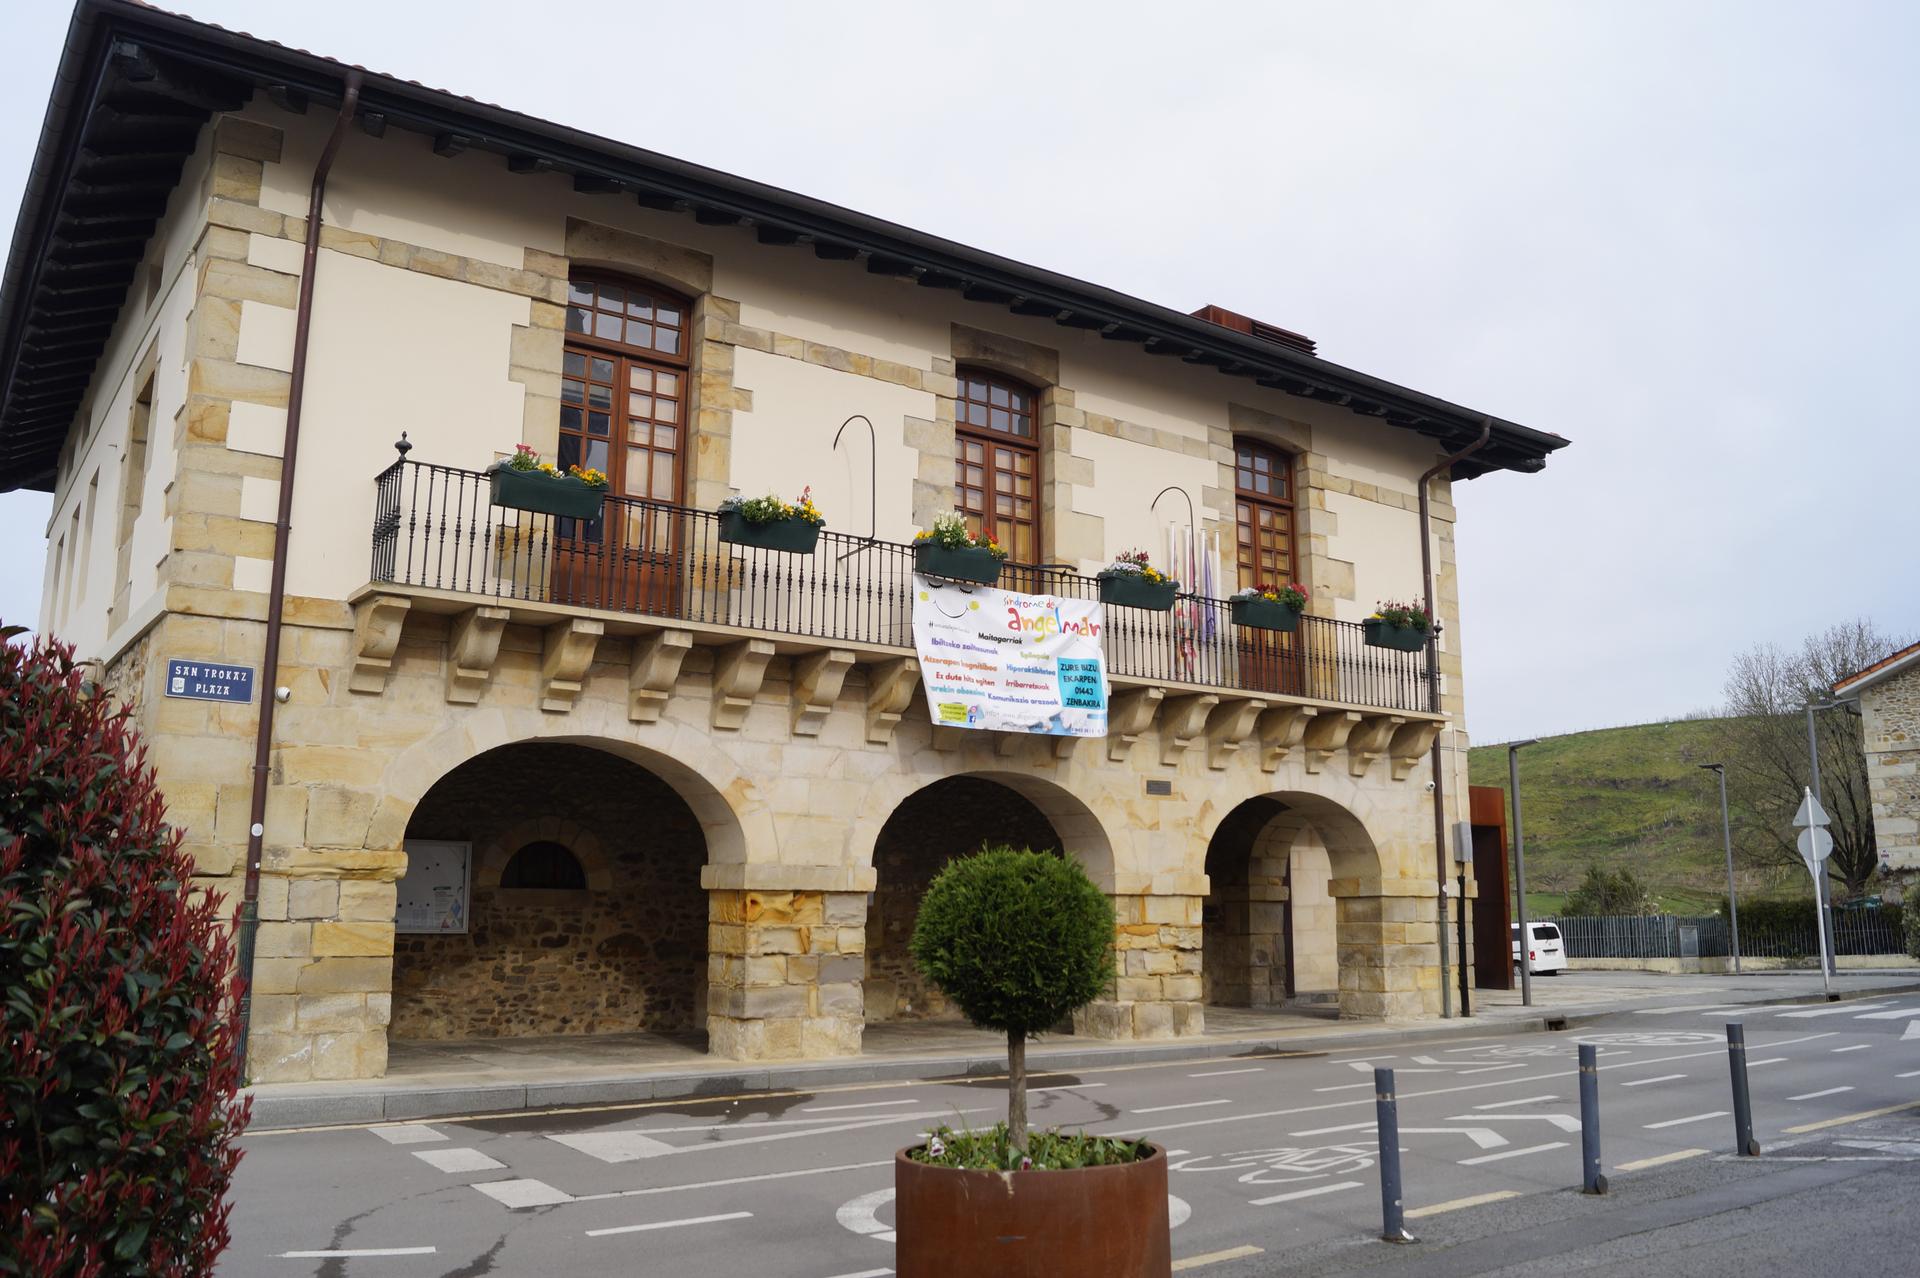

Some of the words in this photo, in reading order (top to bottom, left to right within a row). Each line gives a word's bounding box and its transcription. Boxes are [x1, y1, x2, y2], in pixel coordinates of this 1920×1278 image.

[1008, 607, 1101, 643] angelman
[931, 637, 961, 650] Ibiltzeko
[978, 632, 1023, 645] Maitagarriak
[1060, 663, 1079, 672] ZURE
[175, 666, 198, 677] SAN
[204, 668, 247, 682] TROKAZ
[936, 672, 944, 680] Ez
[945, 673, 962, 681] dute
[195, 683, 230, 695] PLAZA
[1074, 686, 1094, 696] 01443
[987, 692, 1029, 704] Komunikazio
[1066, 697, 1101, 708] ZENBAKIRA
